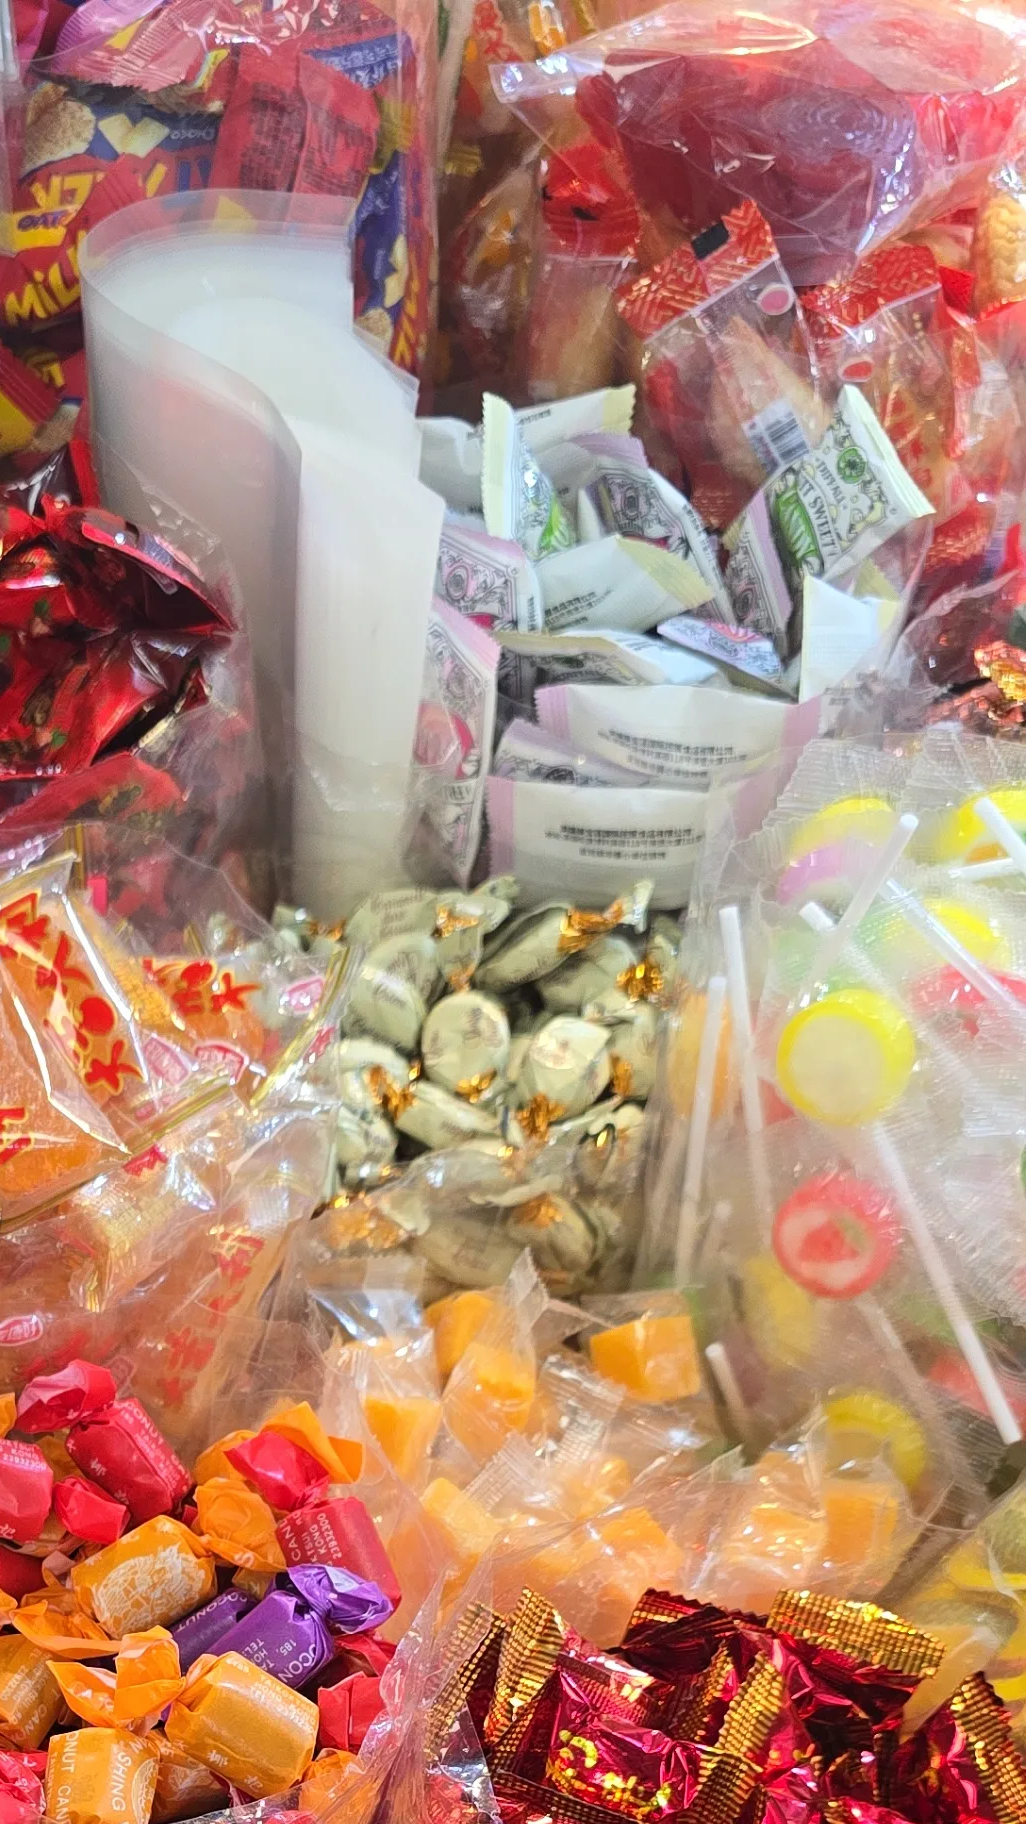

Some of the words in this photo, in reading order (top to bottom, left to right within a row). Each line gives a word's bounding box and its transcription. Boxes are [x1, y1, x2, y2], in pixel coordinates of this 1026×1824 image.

[308, 1523, 329, 1552] KONG
[317, 1512, 343, 1561] 23932300
[112, 1750, 132, 1812] SHING
